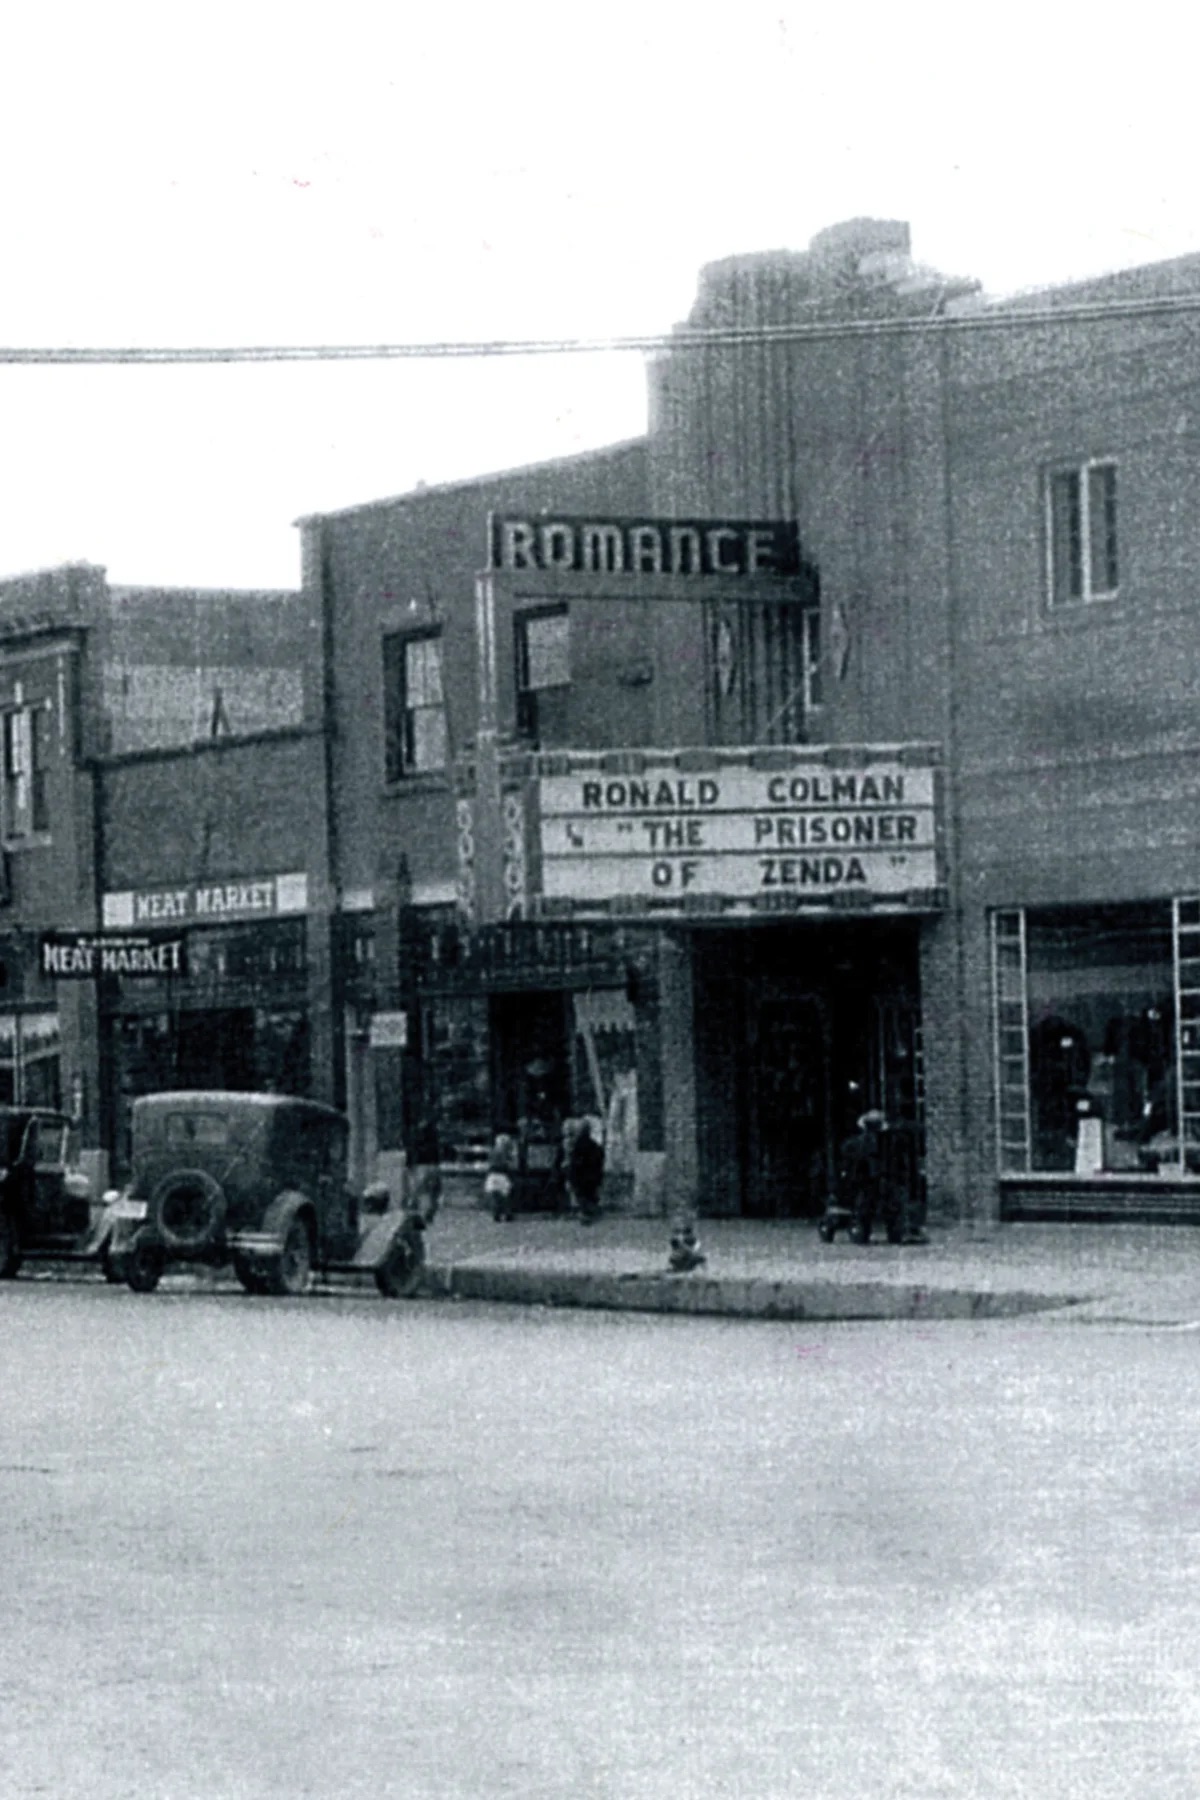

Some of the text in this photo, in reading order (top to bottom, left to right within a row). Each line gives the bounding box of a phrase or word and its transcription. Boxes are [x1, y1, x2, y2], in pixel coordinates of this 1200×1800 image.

[502, 521, 775, 574] ROMANCE
[582, 775, 904, 807] RONALD COLMAN
[754, 815, 918, 844] PRISONER
[652, 861, 699, 888] OF
[137, 882, 273, 919] MEAT MARKET
[43, 940, 182, 972] MEAT MARKET
